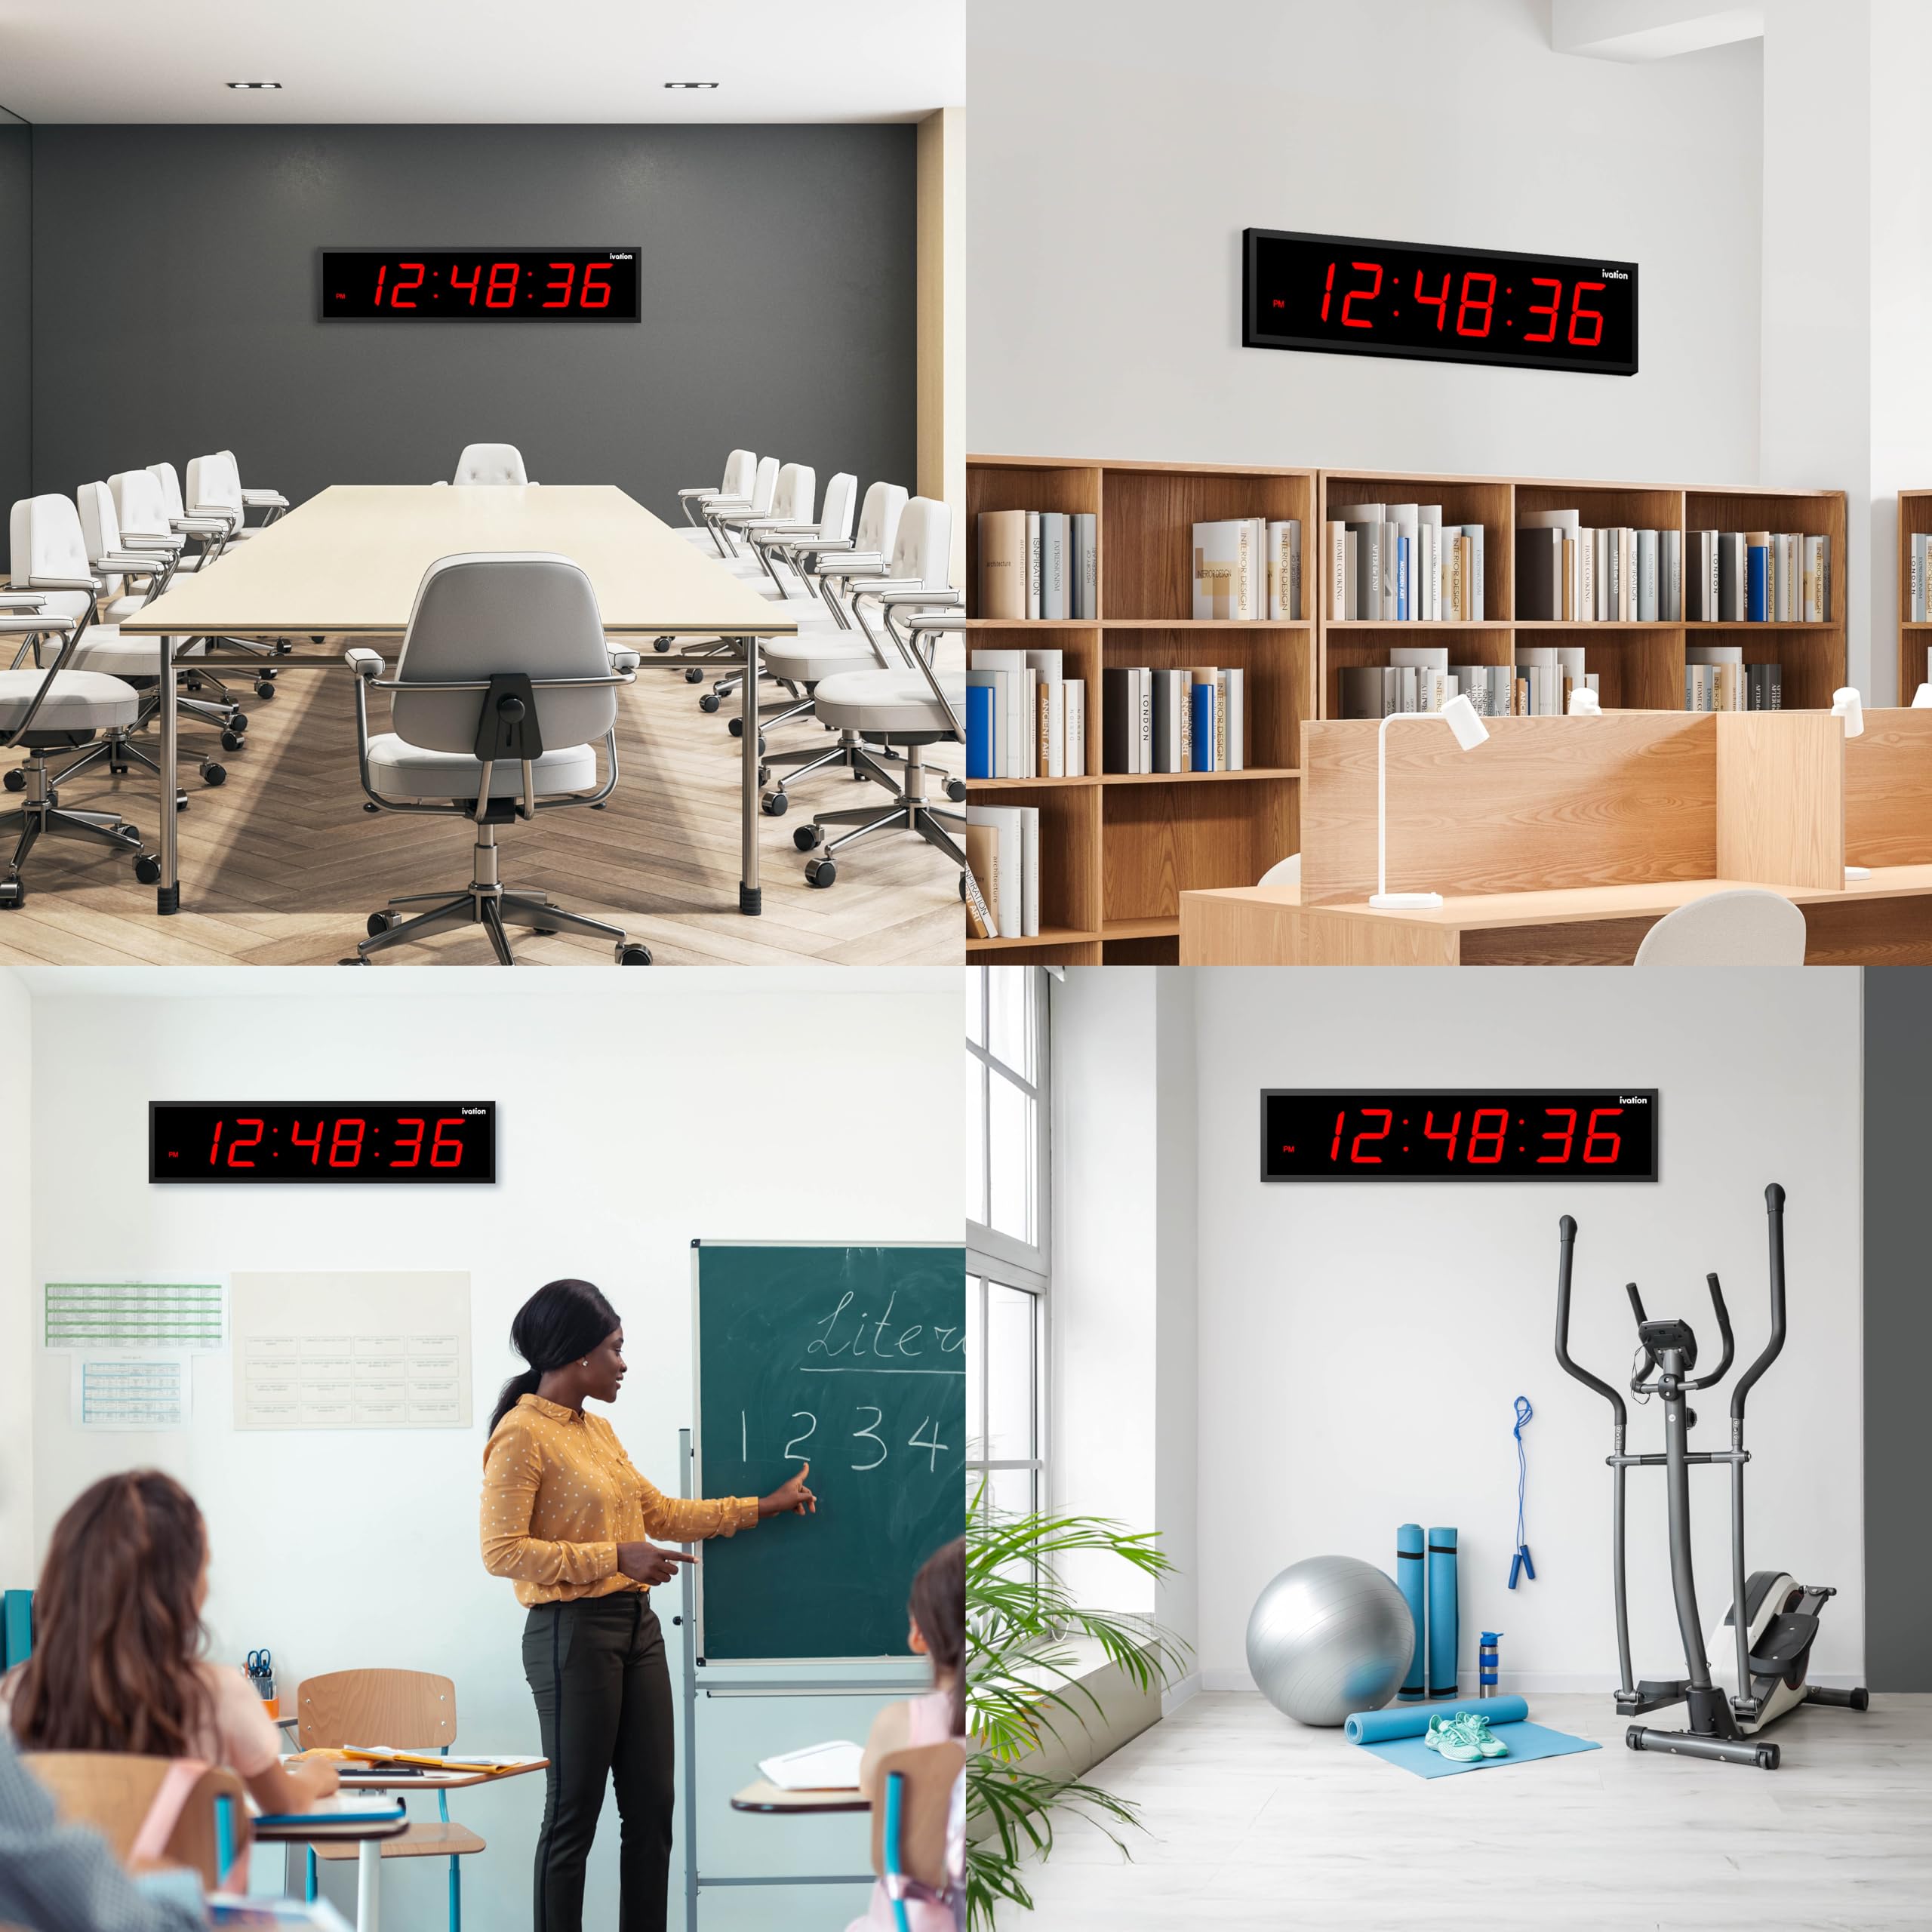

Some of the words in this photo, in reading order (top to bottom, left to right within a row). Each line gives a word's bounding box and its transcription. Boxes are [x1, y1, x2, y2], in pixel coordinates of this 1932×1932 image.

[375, 263, 613, 308] 12:48:36
[1602, 269, 1628, 279] ivation
[1321, 263, 1606, 346] 12:48:36
[210, 1118, 465, 1167] 12:48:36
[1331, 1109, 1623, 1163] 12:48:36
[808, 1291, 966, 1357] Liter
[740, 1410, 747, 1463] 1
[784, 1411, 817, 1461] 2
[851, 1406, 888, 1472] 3
[907, 1416, 949, 1473] 4
